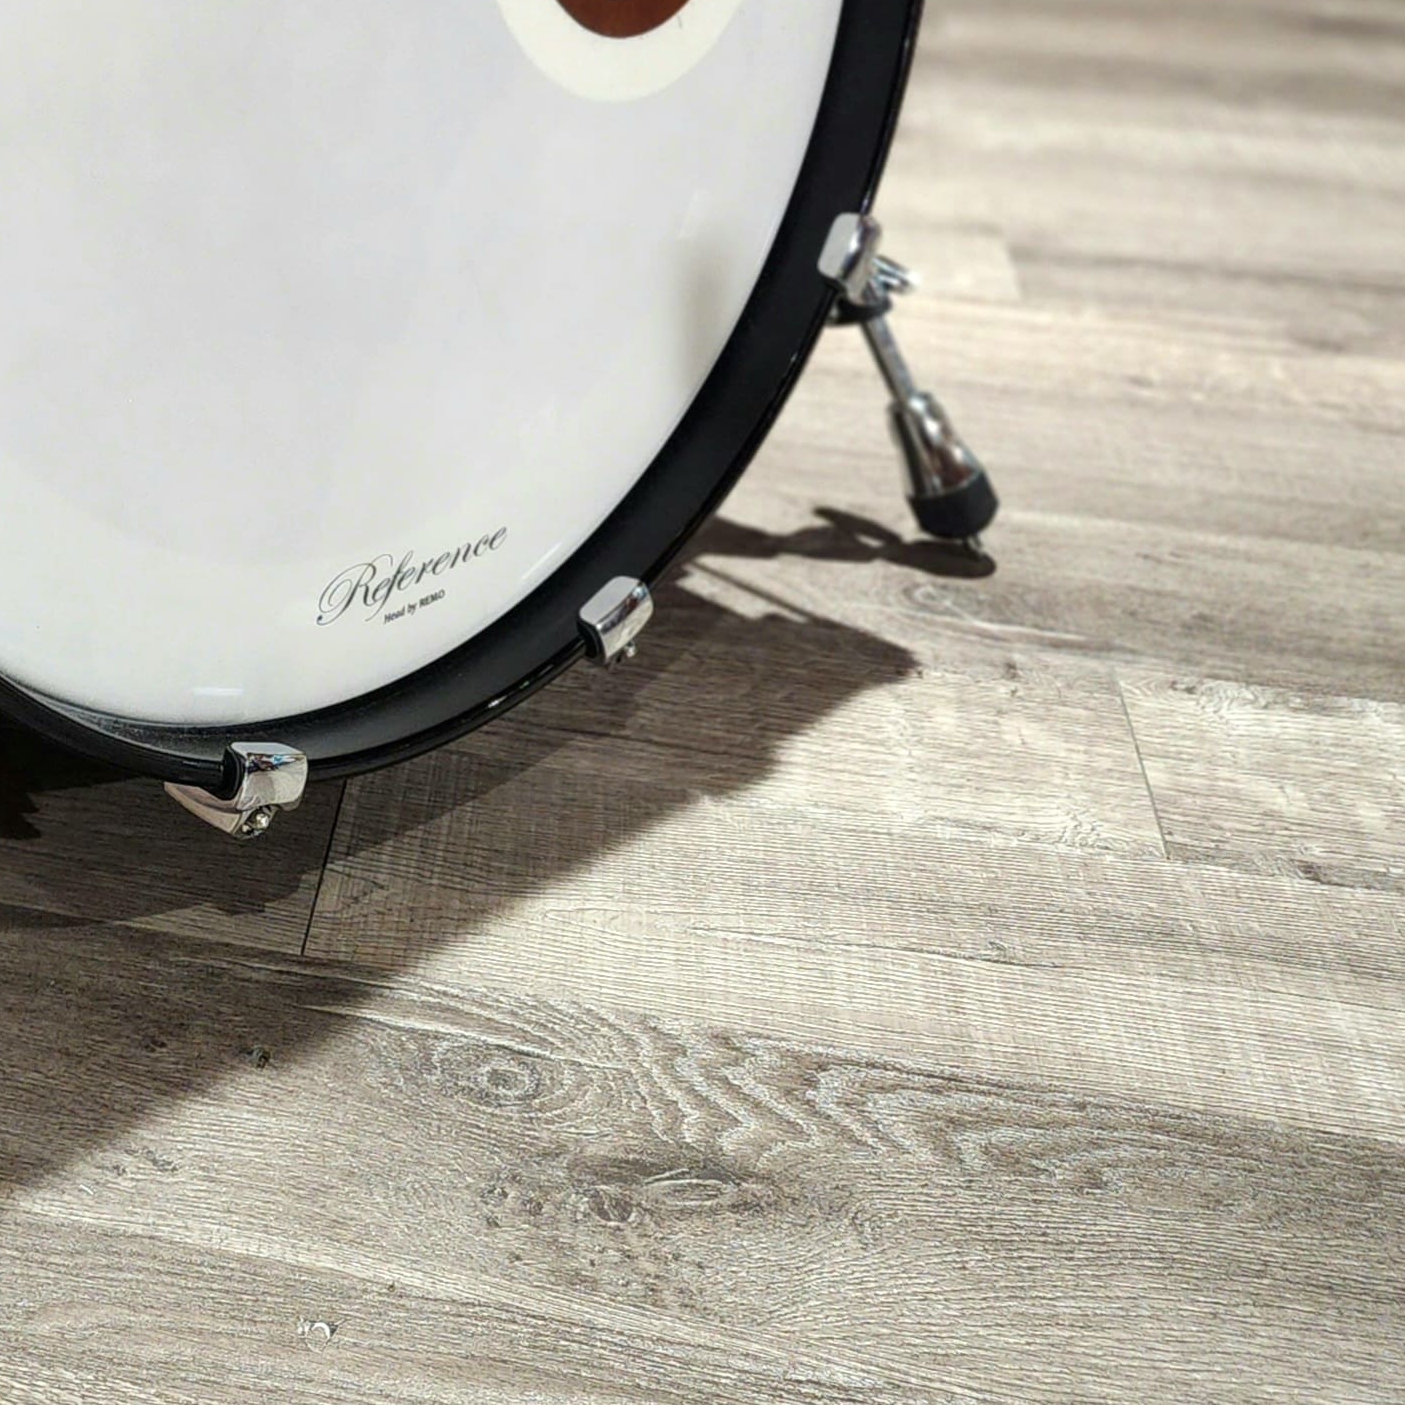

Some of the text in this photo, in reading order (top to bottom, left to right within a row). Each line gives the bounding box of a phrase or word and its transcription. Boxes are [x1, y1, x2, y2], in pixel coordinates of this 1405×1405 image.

[316, 527, 506, 625] Reference
[407, 602, 417, 616] by
[419, 589, 446, 608] REMO
